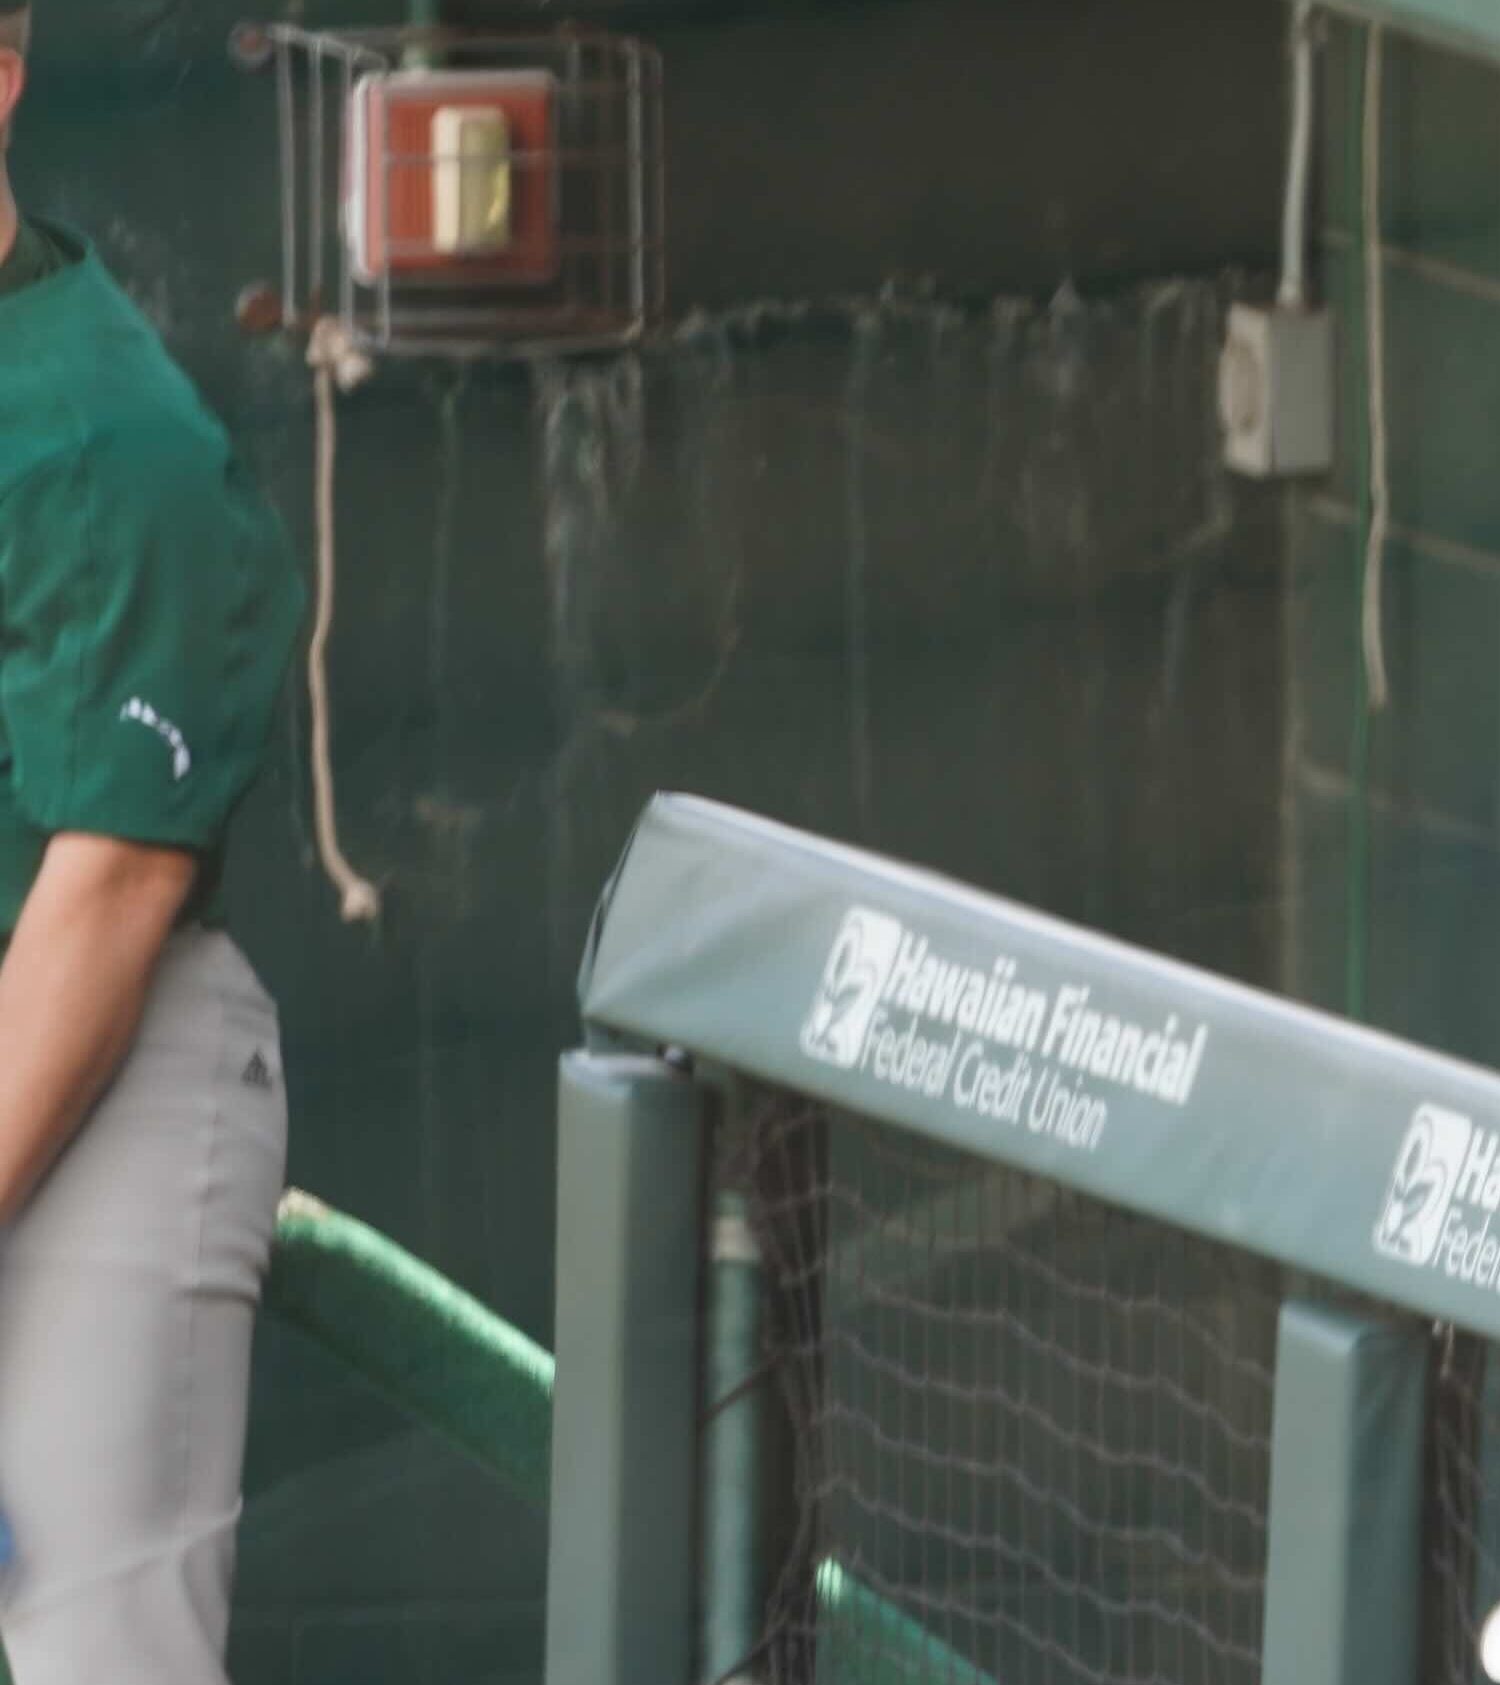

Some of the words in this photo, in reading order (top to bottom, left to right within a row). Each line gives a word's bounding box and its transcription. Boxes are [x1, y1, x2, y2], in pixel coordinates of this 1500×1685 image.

[861, 1006, 962, 1098] Federal
[953, 1041, 1033, 1125] Credit
[1027, 1063, 1108, 1152] Union
[884, 931, 1048, 1053] Hawaiian
[1041, 983, 1209, 1107] Financial
